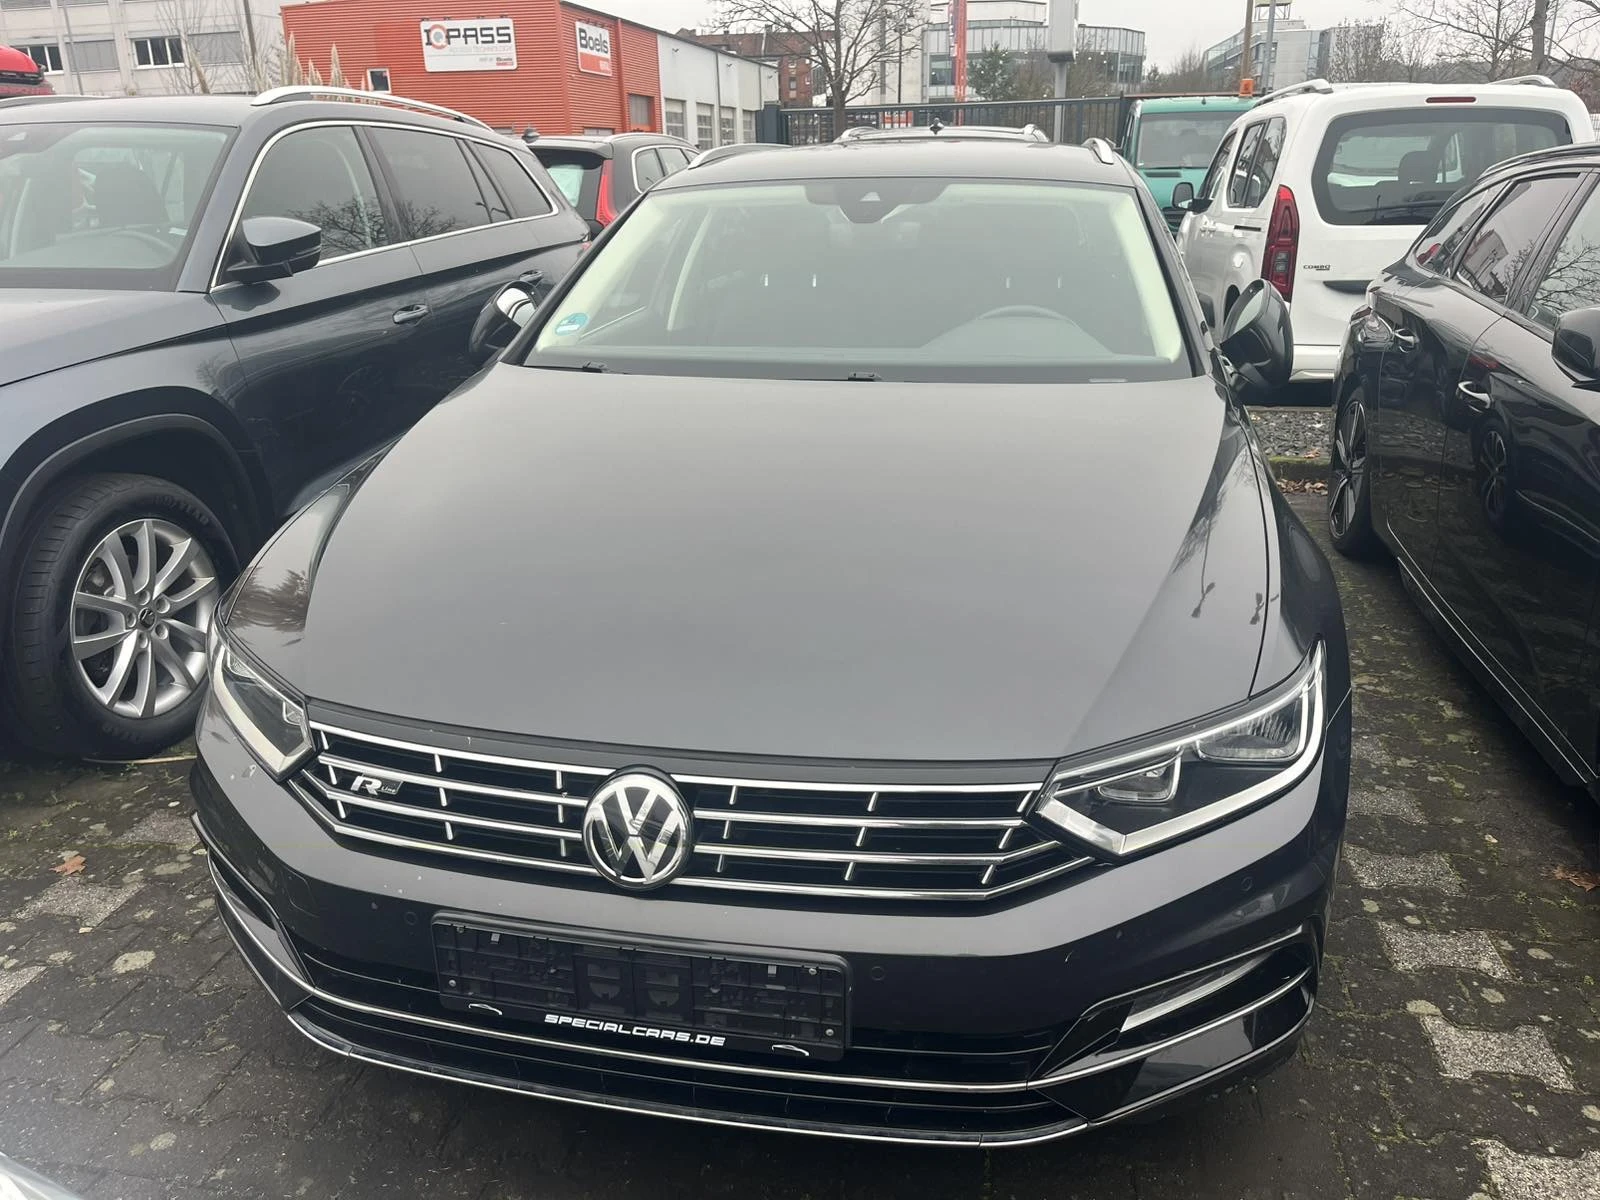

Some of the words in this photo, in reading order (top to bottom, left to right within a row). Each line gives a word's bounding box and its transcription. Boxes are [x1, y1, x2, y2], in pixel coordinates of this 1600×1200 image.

[578, 27, 609, 54] Boels
[350, 775, 382, 796] R
[544, 1013, 727, 1047] SPECIALCARS.DE
